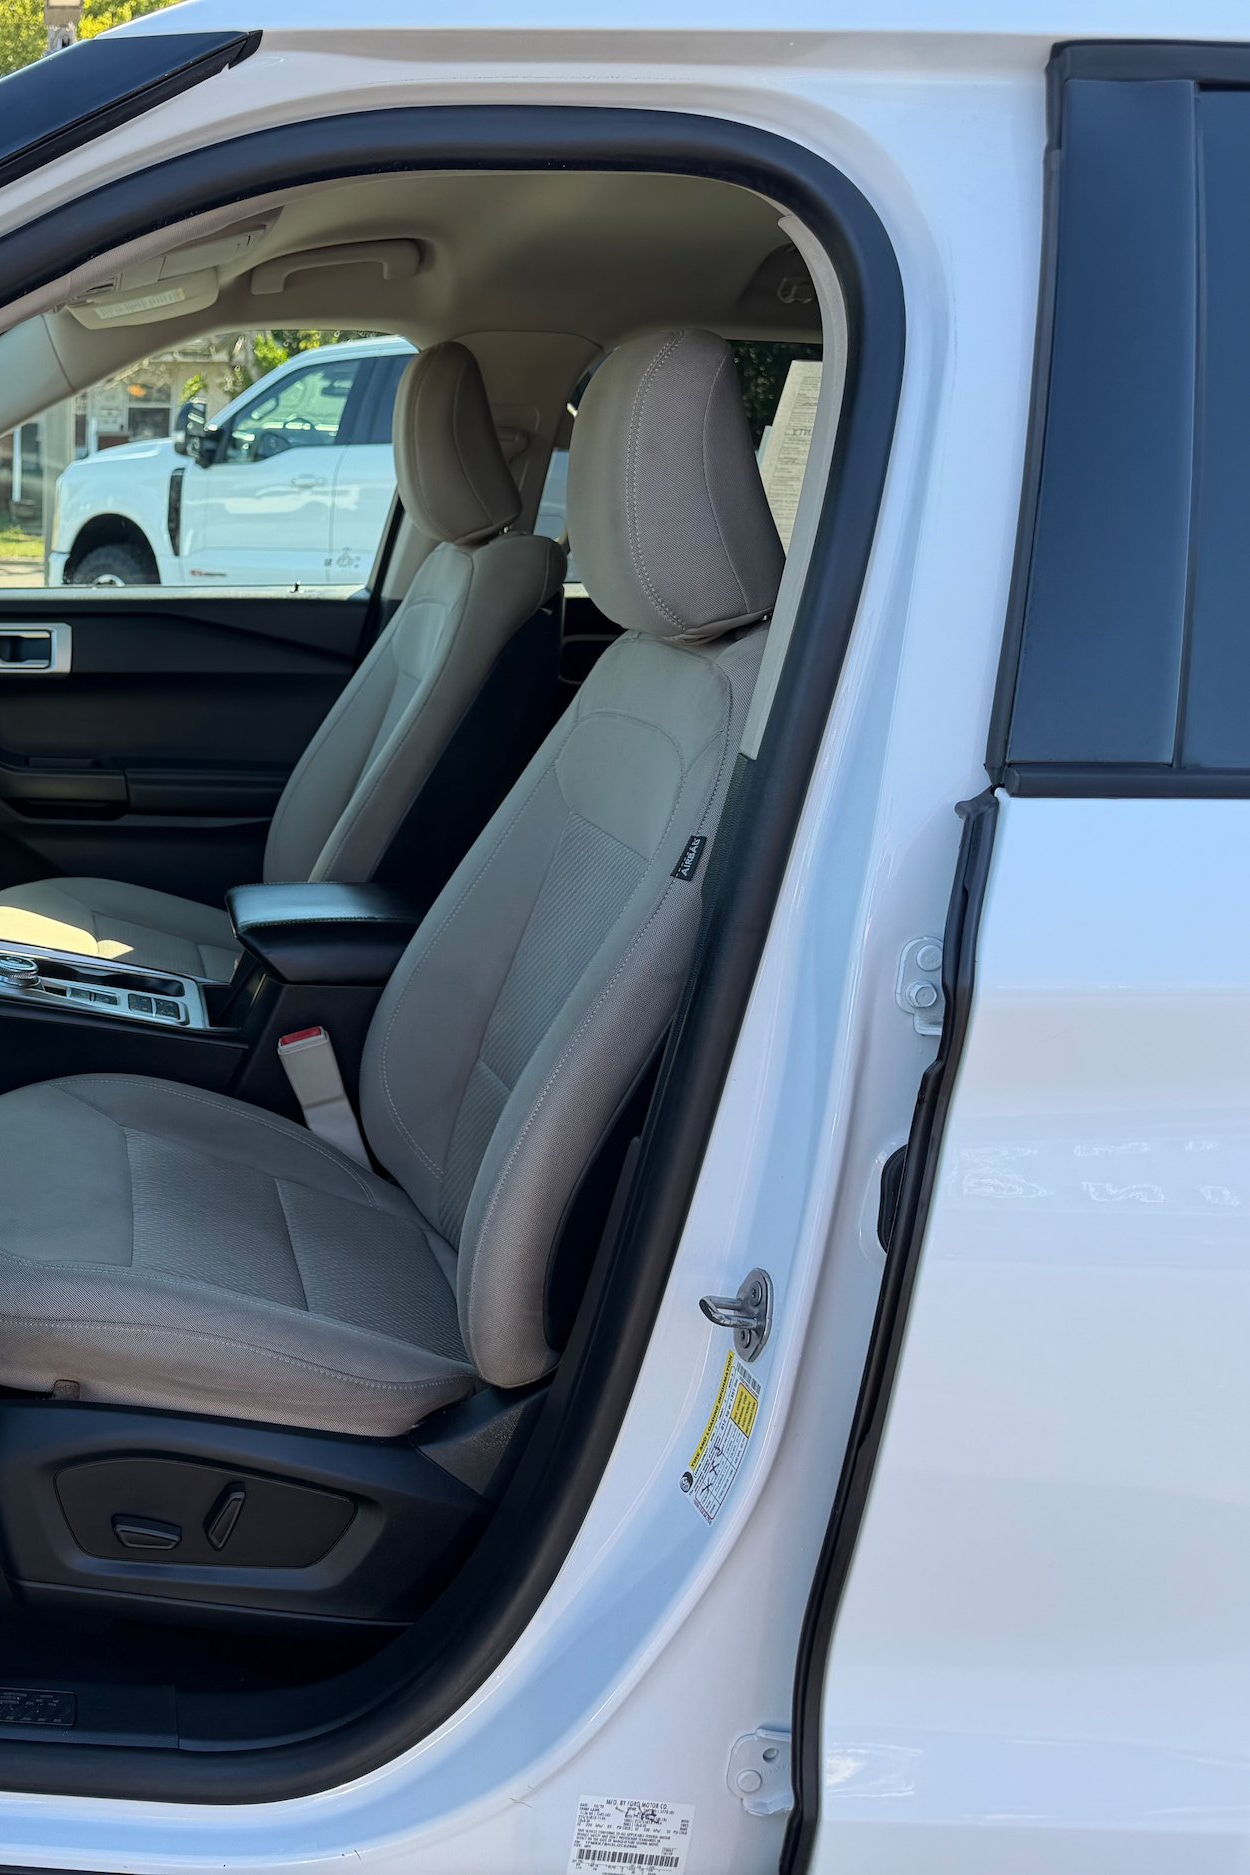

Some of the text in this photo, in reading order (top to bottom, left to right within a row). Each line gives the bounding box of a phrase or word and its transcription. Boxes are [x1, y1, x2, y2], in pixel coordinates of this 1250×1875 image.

[681, 838, 701, 876] AIRBAG
[690, 1354, 733, 1468] TIRE AND LOADING INFORMATION
